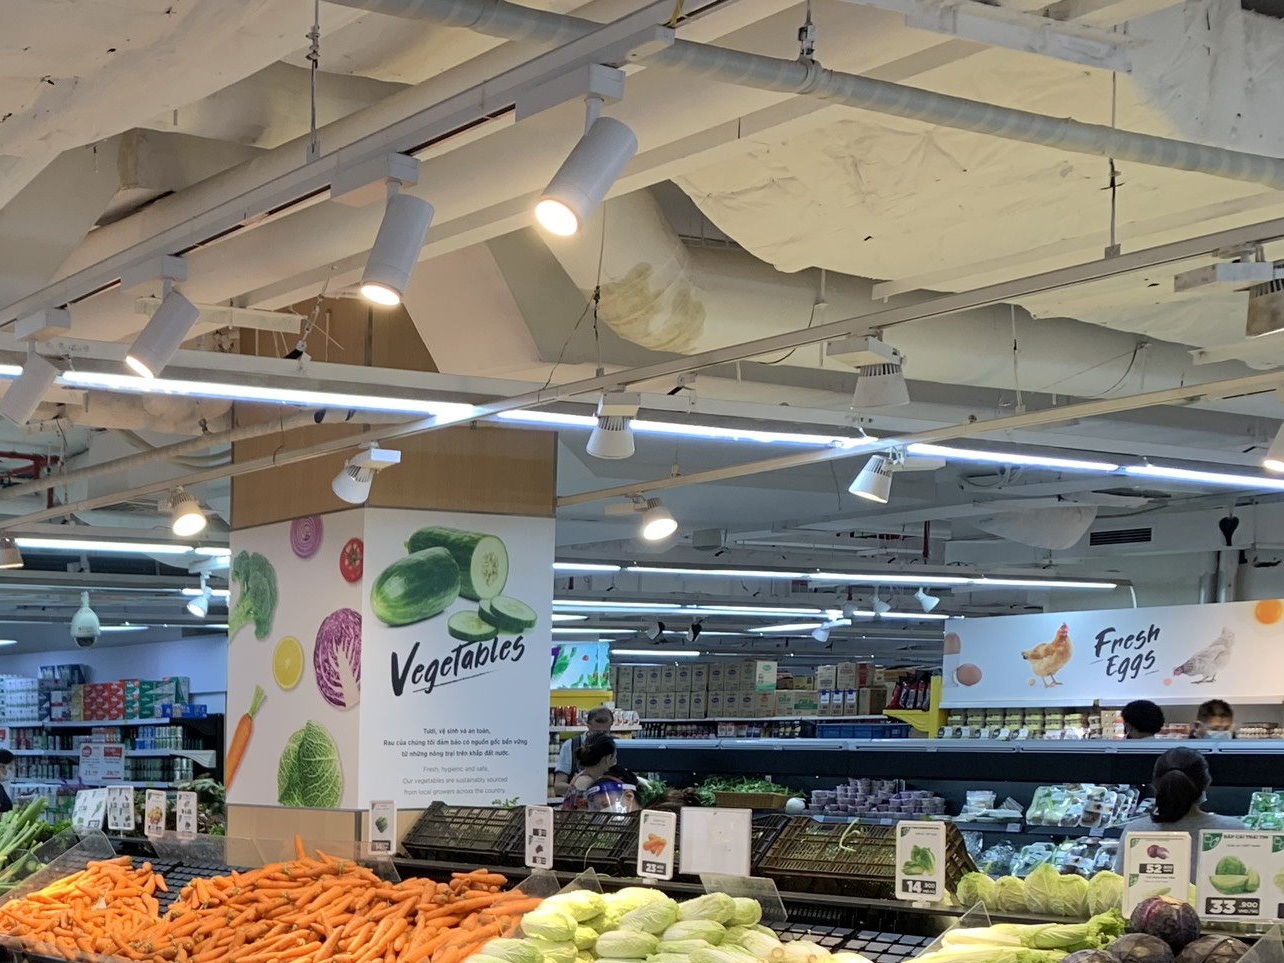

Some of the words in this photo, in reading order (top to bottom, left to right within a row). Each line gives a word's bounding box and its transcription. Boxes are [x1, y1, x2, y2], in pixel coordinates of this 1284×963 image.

[1094, 624, 1160, 658] Fresh
[1106, 650, 1157, 683] Eggs
[646, 863, 656, 873] 23
[1146, 864, 1162, 874] 52
[906, 880, 922, 893] 14
[1210, 900, 1236, 914] 33
